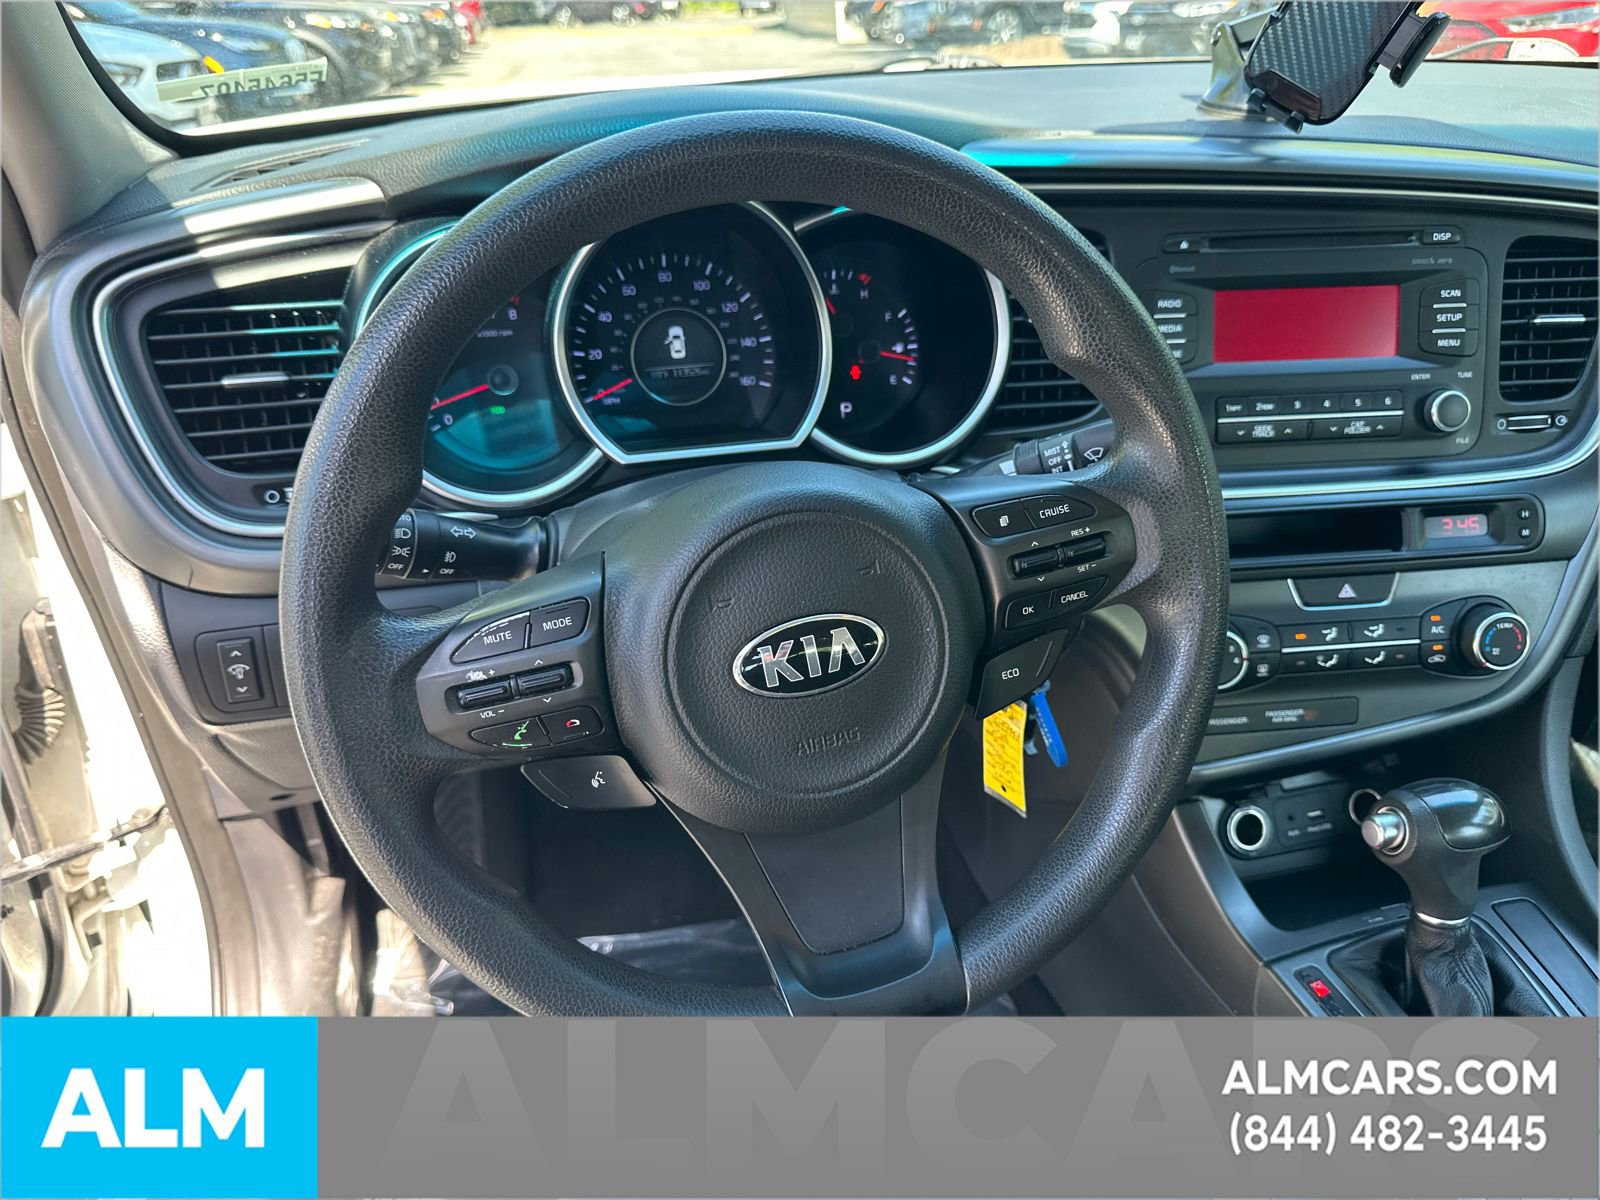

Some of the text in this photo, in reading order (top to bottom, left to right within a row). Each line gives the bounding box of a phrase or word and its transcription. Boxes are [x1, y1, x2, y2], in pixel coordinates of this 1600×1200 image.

[1433, 232, 1451, 241] DISP
[658, 271, 672, 282] 80
[622, 286, 637, 296] 60
[693, 281, 711, 291] 100
[860, 290, 869, 299] H
[1440, 290, 1461, 298] SCAN
[721, 302, 738, 313] 120
[1157, 299, 1182, 308] RADIO
[598, 312, 612, 323] 40
[884, 311, 893, 322] F
[1436, 313, 1463, 322] SETUP
[1157, 324, 1183, 333] MEDIA
[740, 336, 757, 347] 140
[1437, 339, 1461, 347] MENU
[588, 350, 602, 360] 20
[739, 375, 756, 386] 160
[889, 374, 898, 385] E
[1294, 400, 1302, 409] 3
[1323, 399, 1332, 408] 4
[1354, 398, 1362, 407] 5
[1384, 396, 1393, 406] 6
[840, 402, 853, 418] P
[443, 413, 454, 425] 0
[1044, 446, 1061, 457] MIST
[1048, 456, 1062, 466] OFF
[1051, 465, 1063, 474] INT
[1039, 503, 1071, 520] CRUISE
[1521, 510, 1529, 518] H
[1071, 529, 1084, 537] RES
[1521, 528, 1530, 536] M
[387, 562, 405, 570] OFF
[1077, 564, 1090, 573] SET
[1060, 590, 1089, 604] CANCEL
[1022, 605, 1035, 615] OK
[542, 616, 573, 632] MODE
[1496, 622, 1514, 630] TEMP
[1431, 625, 1445, 634] A/C
[483, 630, 513, 646] MUTE
[757, 627, 865, 688] KIA
[1001, 667, 1020, 680] ECO
[480, 710, 496, 719] VOL
[1264, 708, 1304, 717] PASSENGER
[1208, 716, 1248, 726] ASSENGER
[797, 727, 862, 755] AIRBAG
